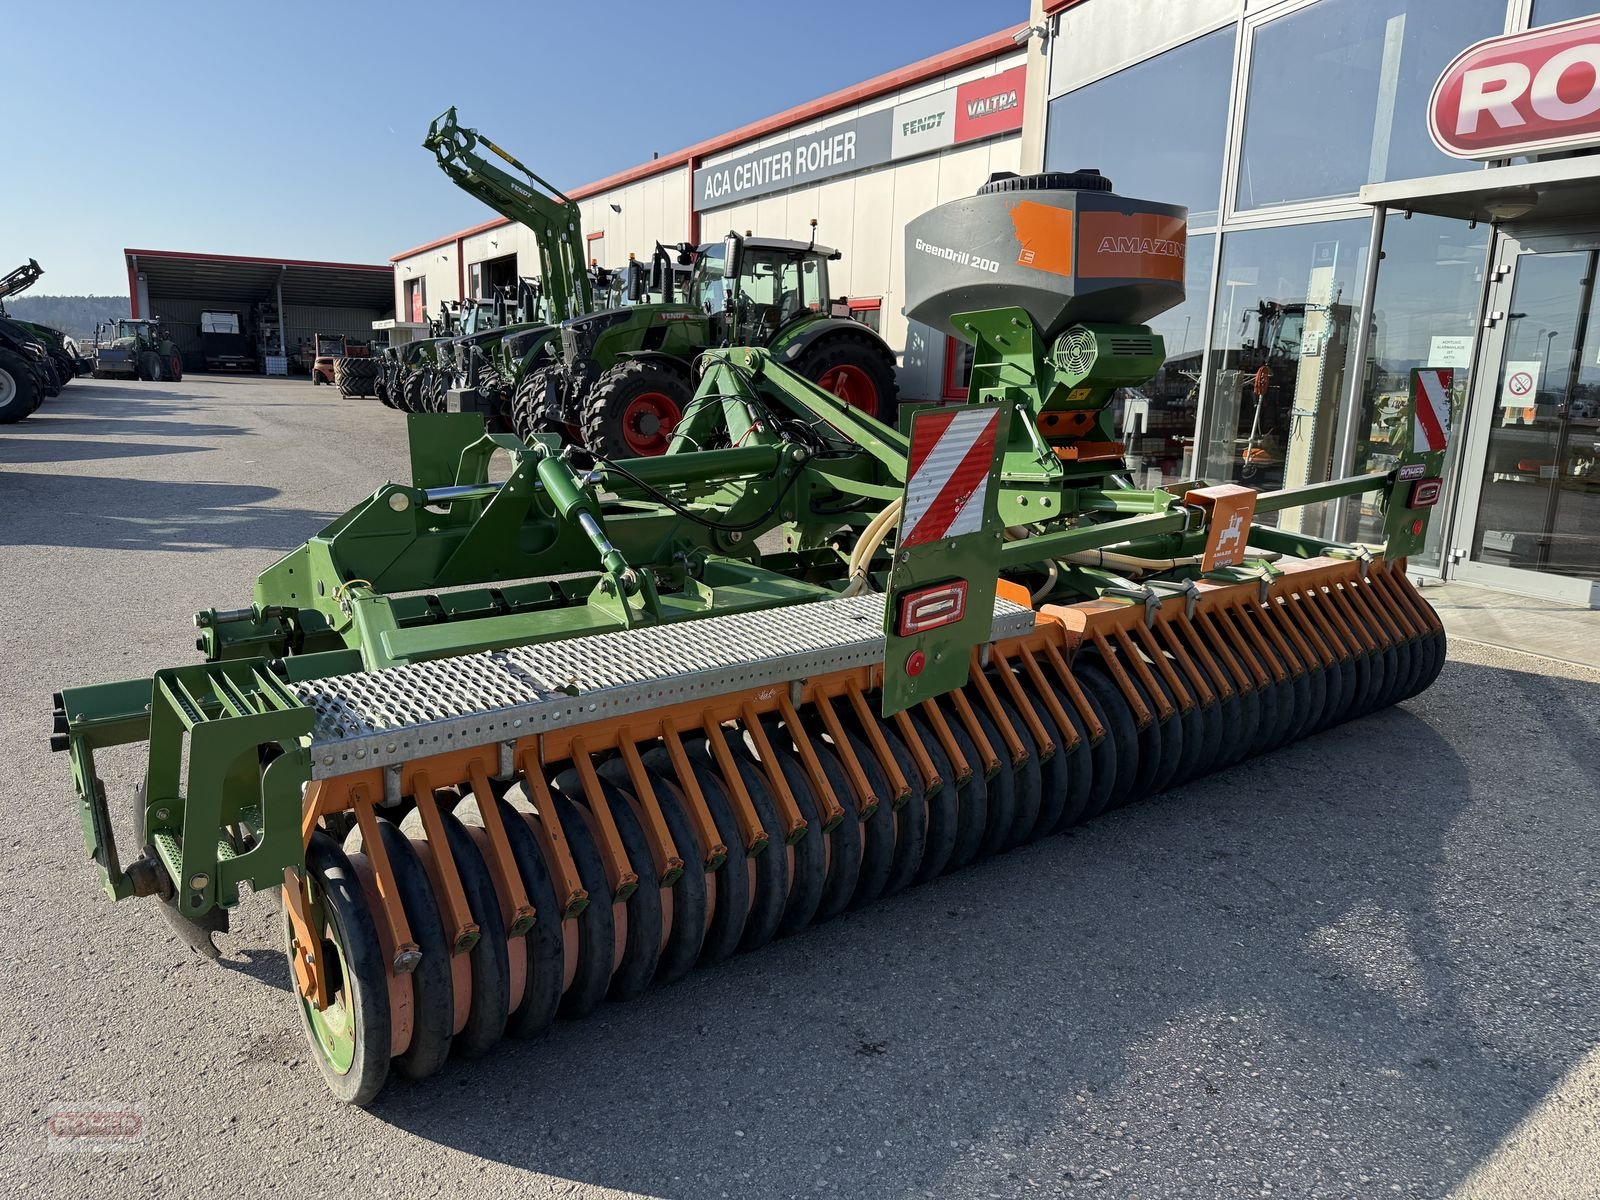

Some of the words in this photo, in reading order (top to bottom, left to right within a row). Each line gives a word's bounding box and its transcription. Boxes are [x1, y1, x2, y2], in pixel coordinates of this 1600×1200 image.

[966, 89, 1018, 120] VALTRA
[902, 111, 945, 136] FENDT
[704, 170, 731, 200] ACA
[733, 150, 792, 192] CENTER
[795, 131, 857, 175] ROHER
[915, 238, 970, 265] GreenDrill
[970, 255, 1000, 273] 200
